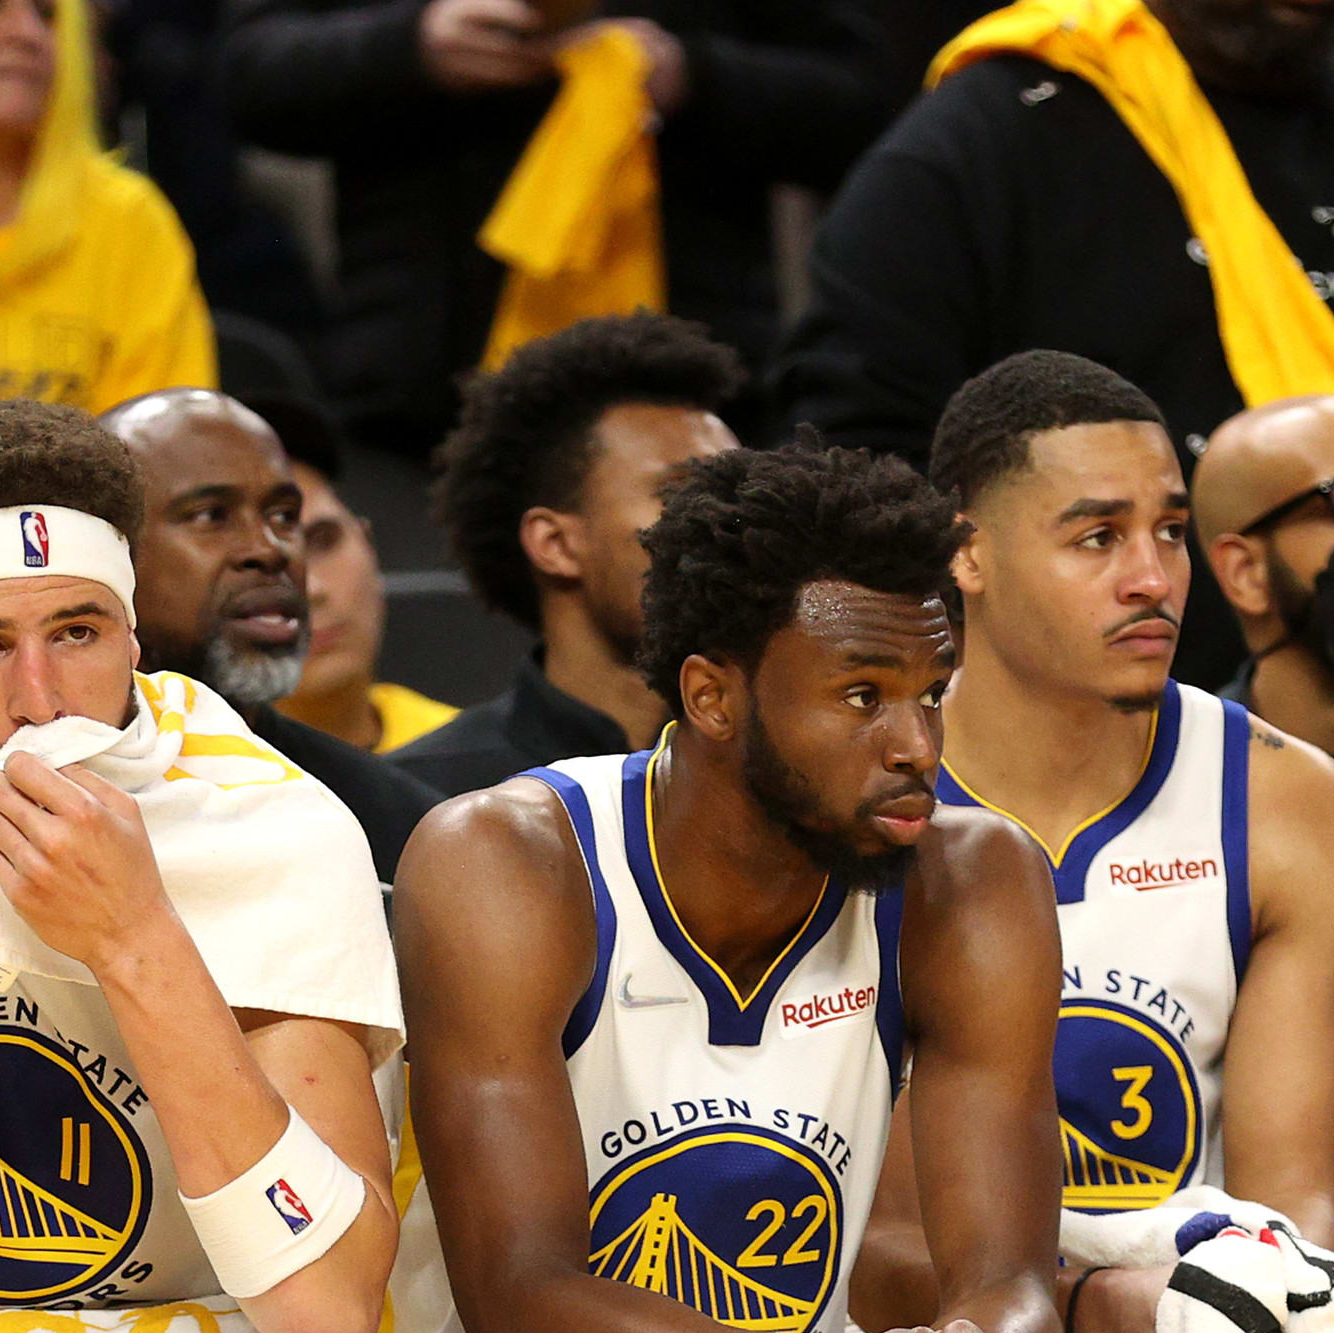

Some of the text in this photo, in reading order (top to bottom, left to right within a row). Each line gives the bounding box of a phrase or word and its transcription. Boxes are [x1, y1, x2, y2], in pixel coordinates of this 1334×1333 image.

[1109, 857, 1218, 892] Rakuten
[782, 986, 876, 1028] Rakuten
[1105, 969, 1196, 1043] STATE
[54, 1026, 149, 1116] TATE
[1110, 1065, 1154, 1140] 3
[59, 1116, 91, 1186] 11
[600, 1098, 853, 1177] GOLDEN STATE
[736, 1194, 828, 1268] 22
